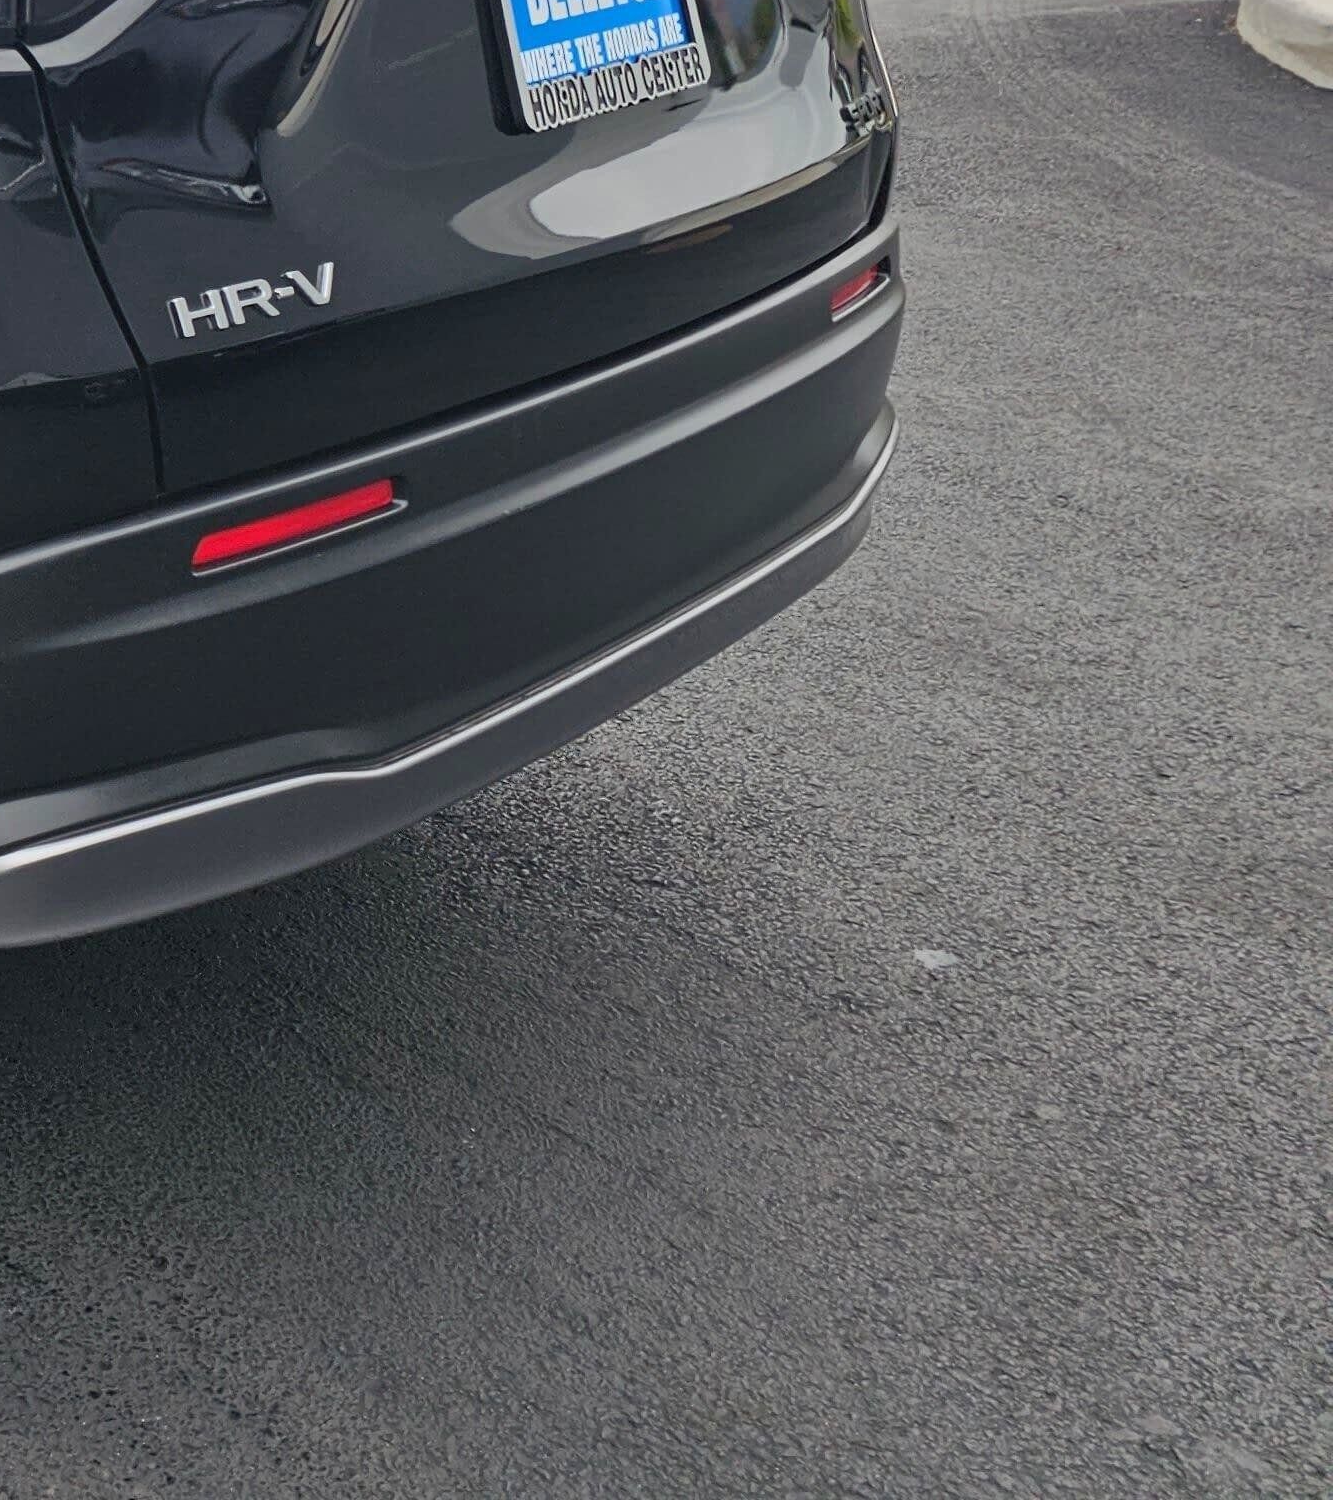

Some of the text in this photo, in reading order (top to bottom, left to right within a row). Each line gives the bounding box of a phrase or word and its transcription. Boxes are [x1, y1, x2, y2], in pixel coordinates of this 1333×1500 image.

[520, 12, 684, 81] WHERE THE HONDAS ARE
[529, 47, 705, 129] HONDA AUTO CENTER
[166, 261, 334, 339] HR-V
